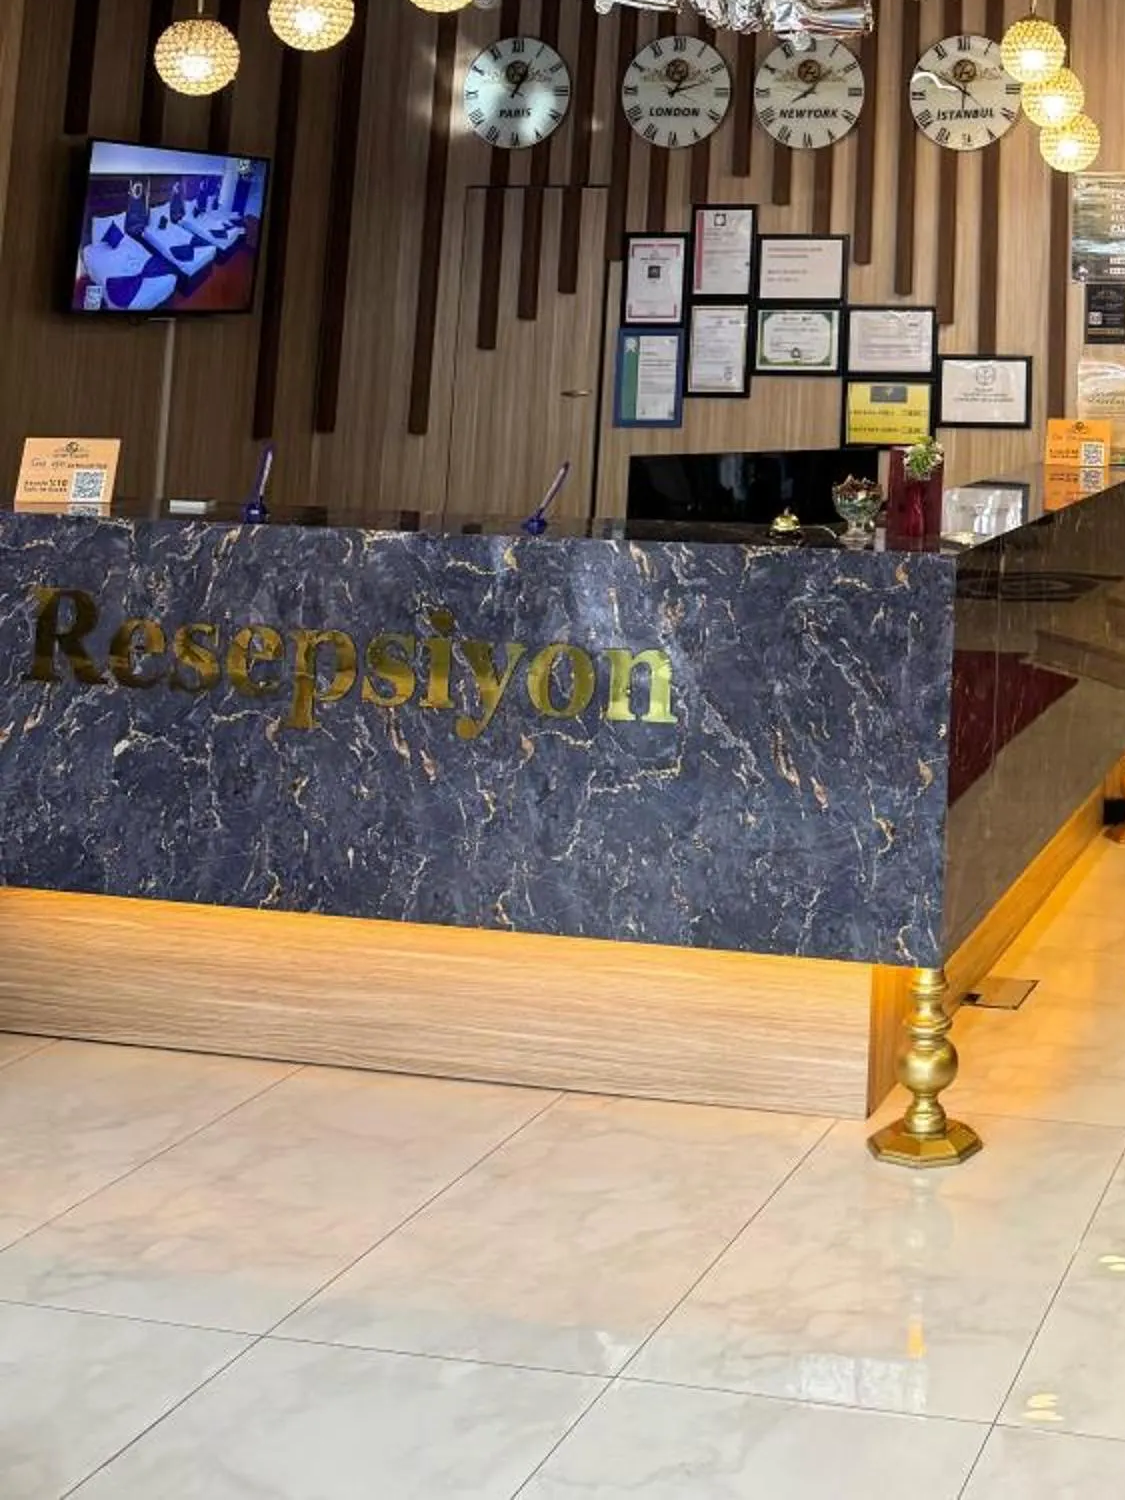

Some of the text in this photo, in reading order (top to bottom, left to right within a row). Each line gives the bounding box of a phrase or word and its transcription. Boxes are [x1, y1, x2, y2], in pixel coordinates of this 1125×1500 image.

[500, 108, 531, 118] PARIS
[649, 107, 700, 117] LONDON
[25, 587, 678, 740] Resepsiyon
